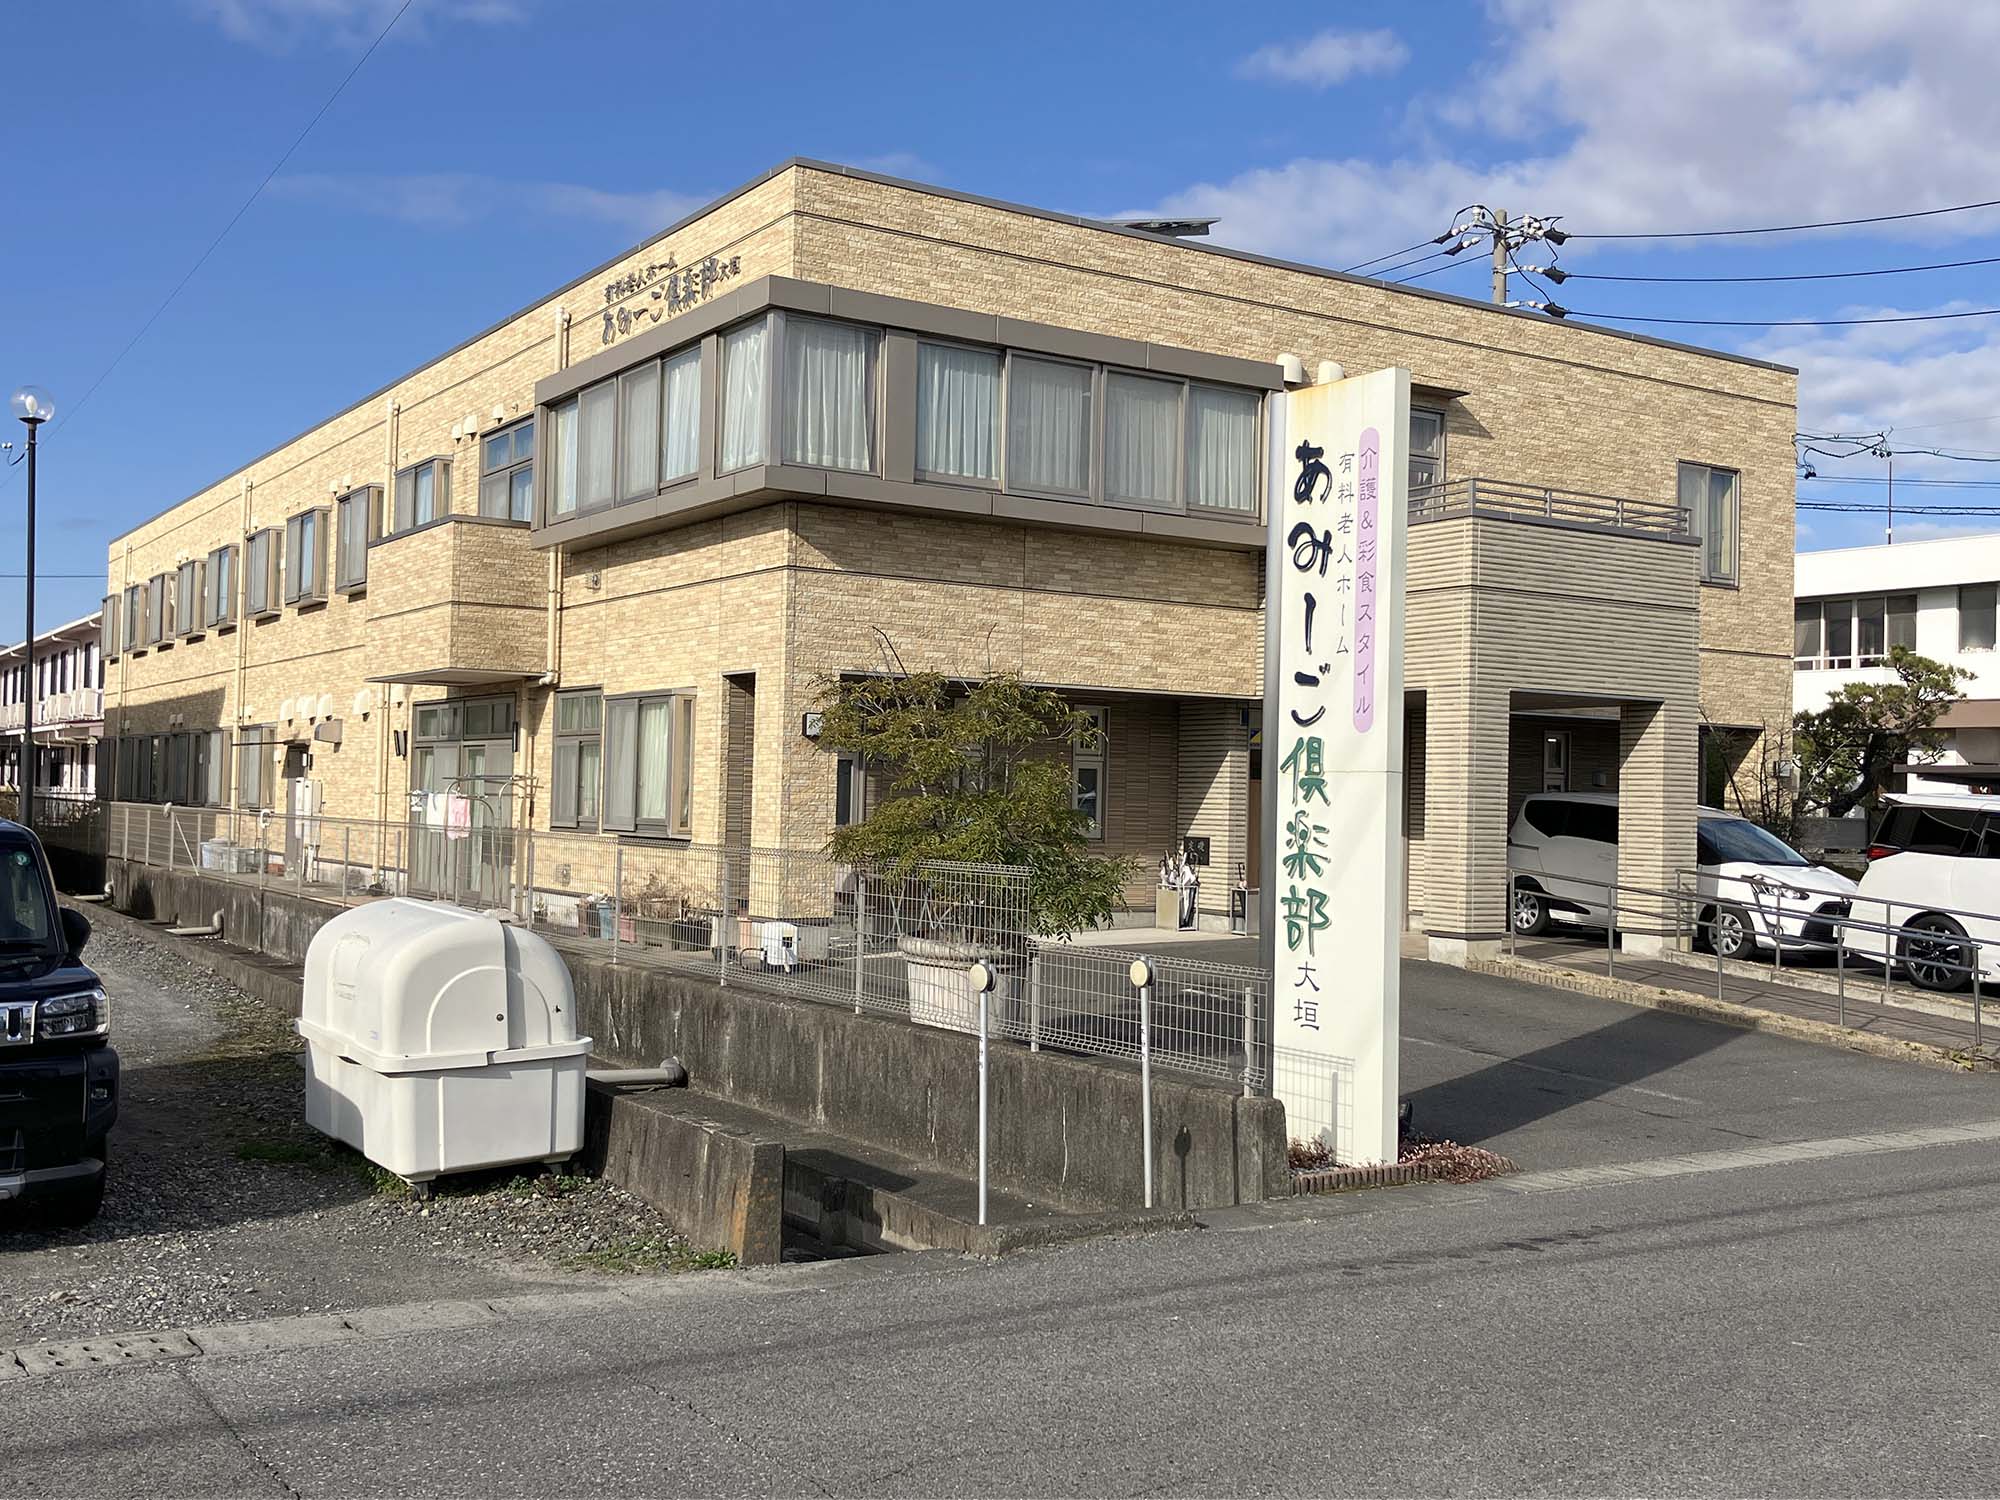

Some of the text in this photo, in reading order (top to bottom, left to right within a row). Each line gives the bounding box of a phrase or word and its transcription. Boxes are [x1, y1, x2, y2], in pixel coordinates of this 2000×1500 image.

[1336, 452, 1355, 655] 有料老人ホーム
[1356, 447, 1377, 714] 介護&彩食スタイル
